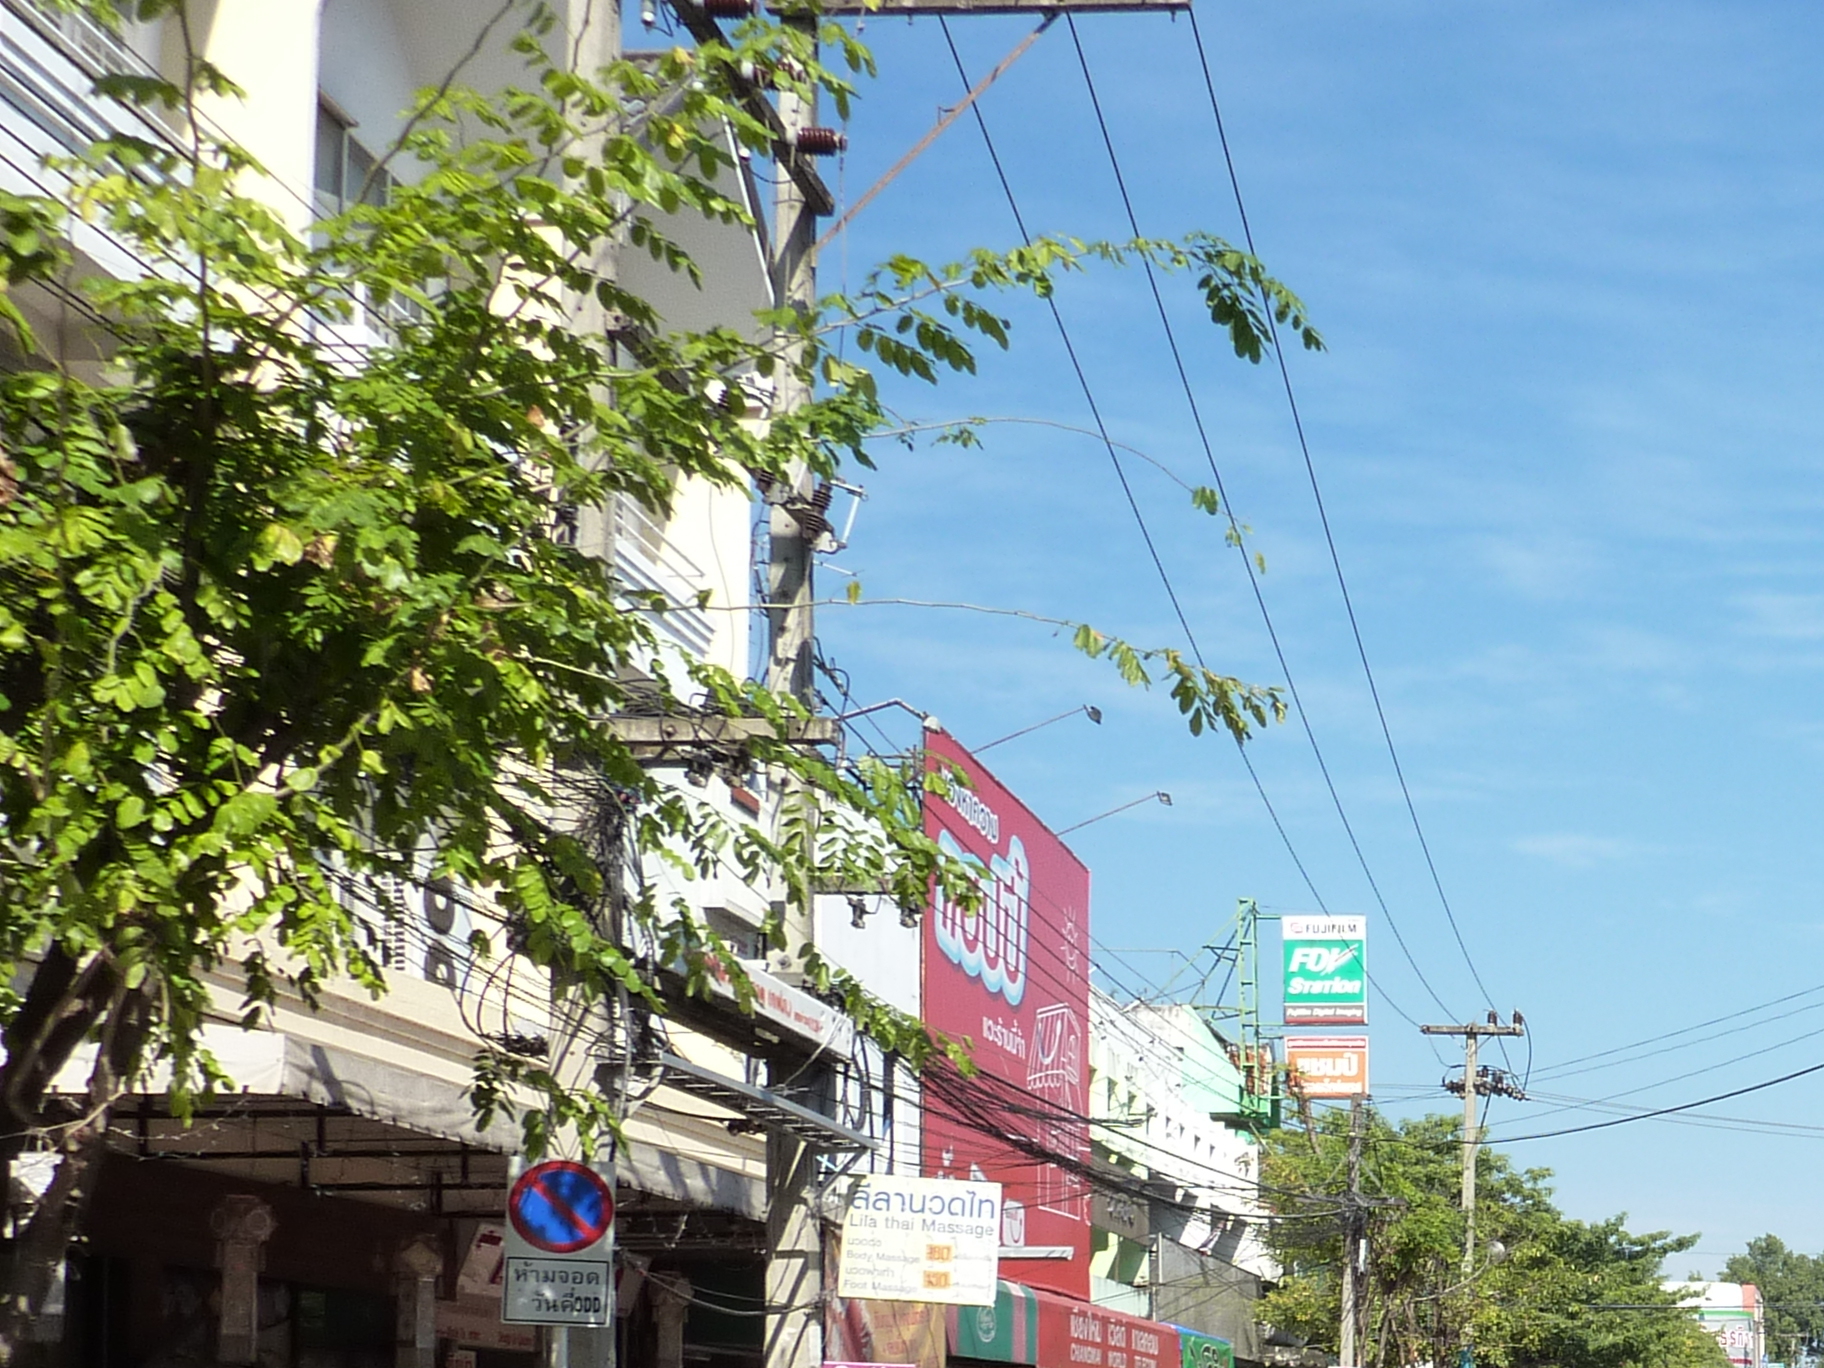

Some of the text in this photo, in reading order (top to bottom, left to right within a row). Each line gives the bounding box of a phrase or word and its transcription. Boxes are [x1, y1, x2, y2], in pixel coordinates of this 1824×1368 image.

[1306, 923, 1357, 934] FUJIFILM
[885, 1216, 915, 1231] thai
[921, 1218, 995, 1239] Massage
[514, 1261, 599, 1285] ห้ามจอด
